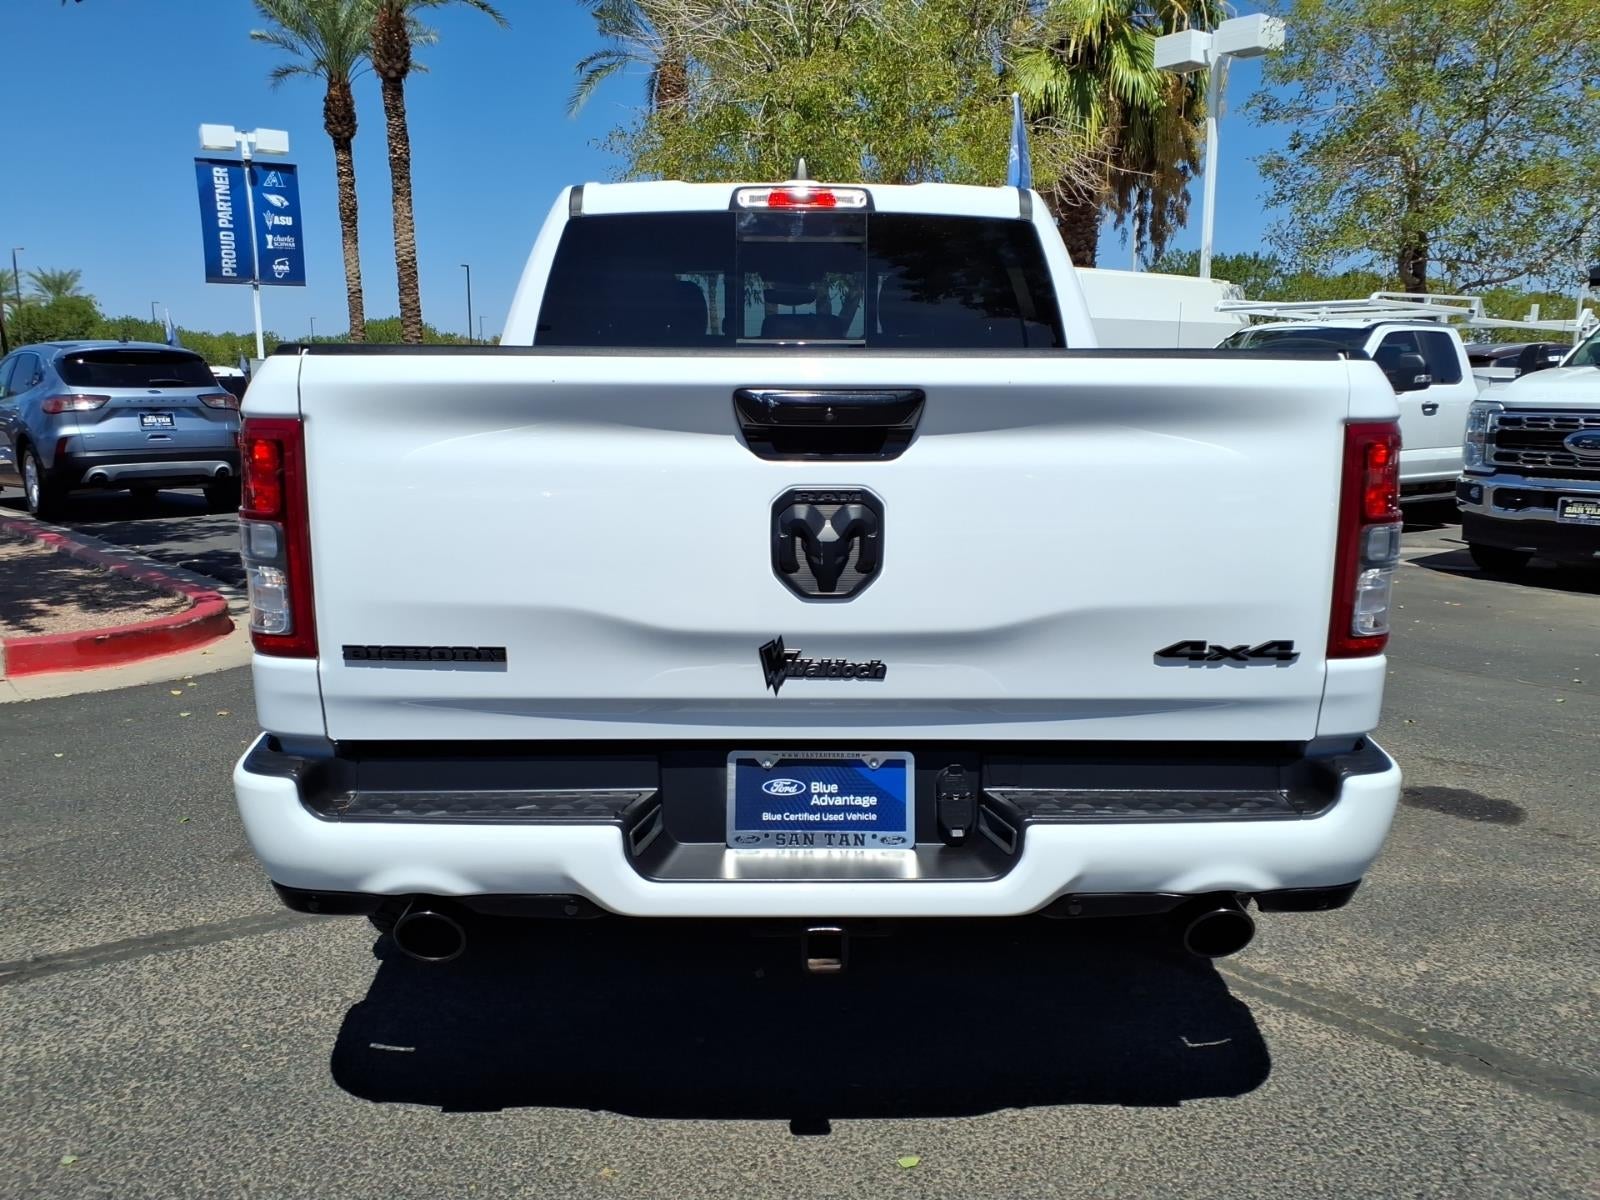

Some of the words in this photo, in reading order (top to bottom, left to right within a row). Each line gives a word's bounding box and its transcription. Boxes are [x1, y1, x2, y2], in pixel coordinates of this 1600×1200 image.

[213, 167, 233, 228] PARTNER
[273, 215, 293, 226] ASU
[219, 231, 237, 277] PROUD
[770, 780, 798, 794] Ford
[811, 782, 838, 793] Blue
[810, 794, 878, 808] Advantage
[762, 812, 782, 821] Blue
[783, 812, 820, 821] Certified
[822, 812, 844, 821] Used
[846, 812, 878, 821] Vehicle
[775, 833, 815, 846] SAN
[825, 833, 866, 846] TAN
